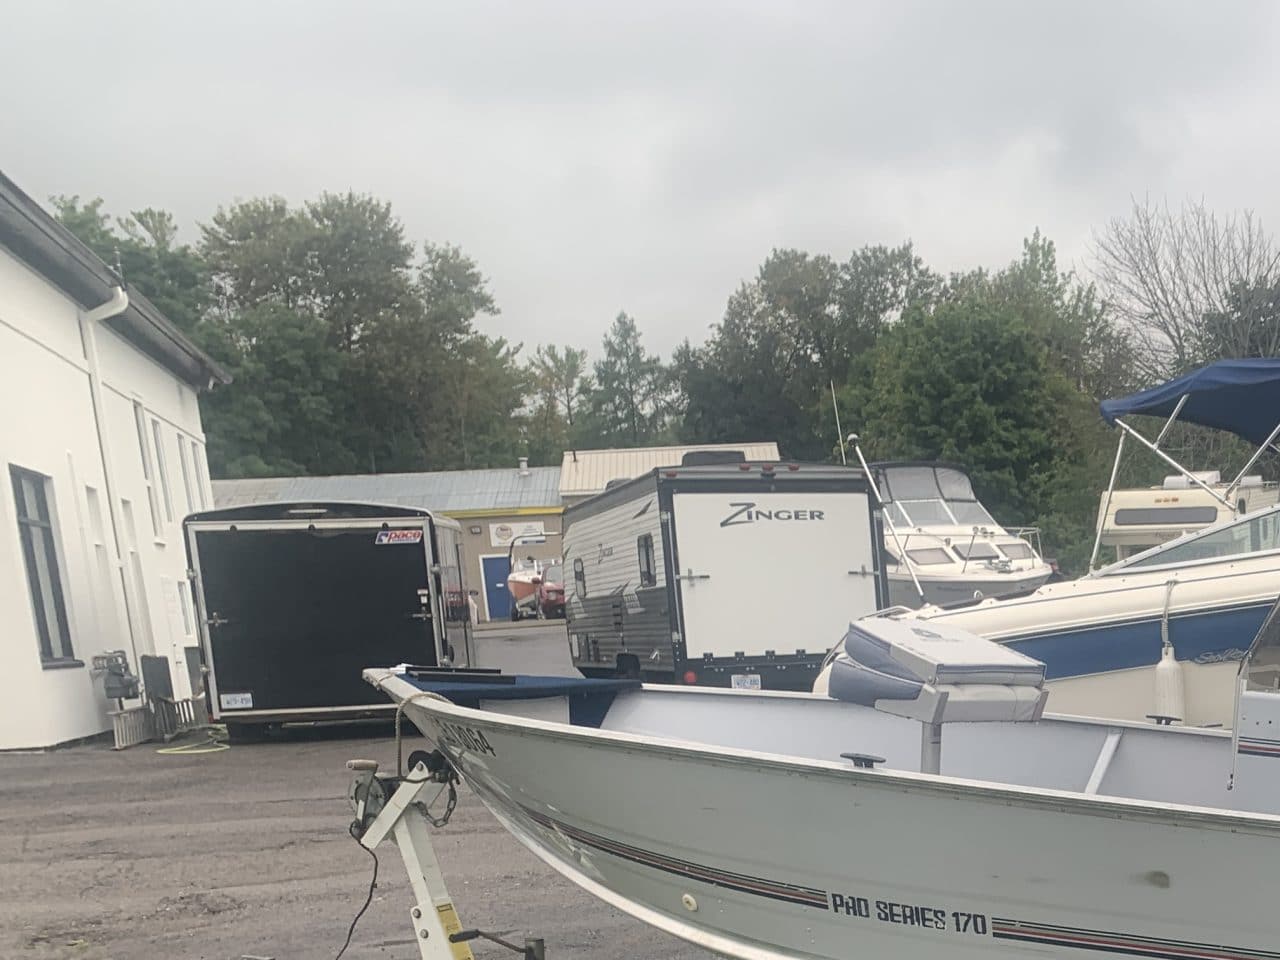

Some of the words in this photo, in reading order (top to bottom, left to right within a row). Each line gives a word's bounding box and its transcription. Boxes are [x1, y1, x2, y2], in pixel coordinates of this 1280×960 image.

[720, 502, 825, 528] ZINGER
[831, 893, 870, 918] PRO
[875, 900, 946, 930] SERIES
[952, 911, 987, 935] 170
